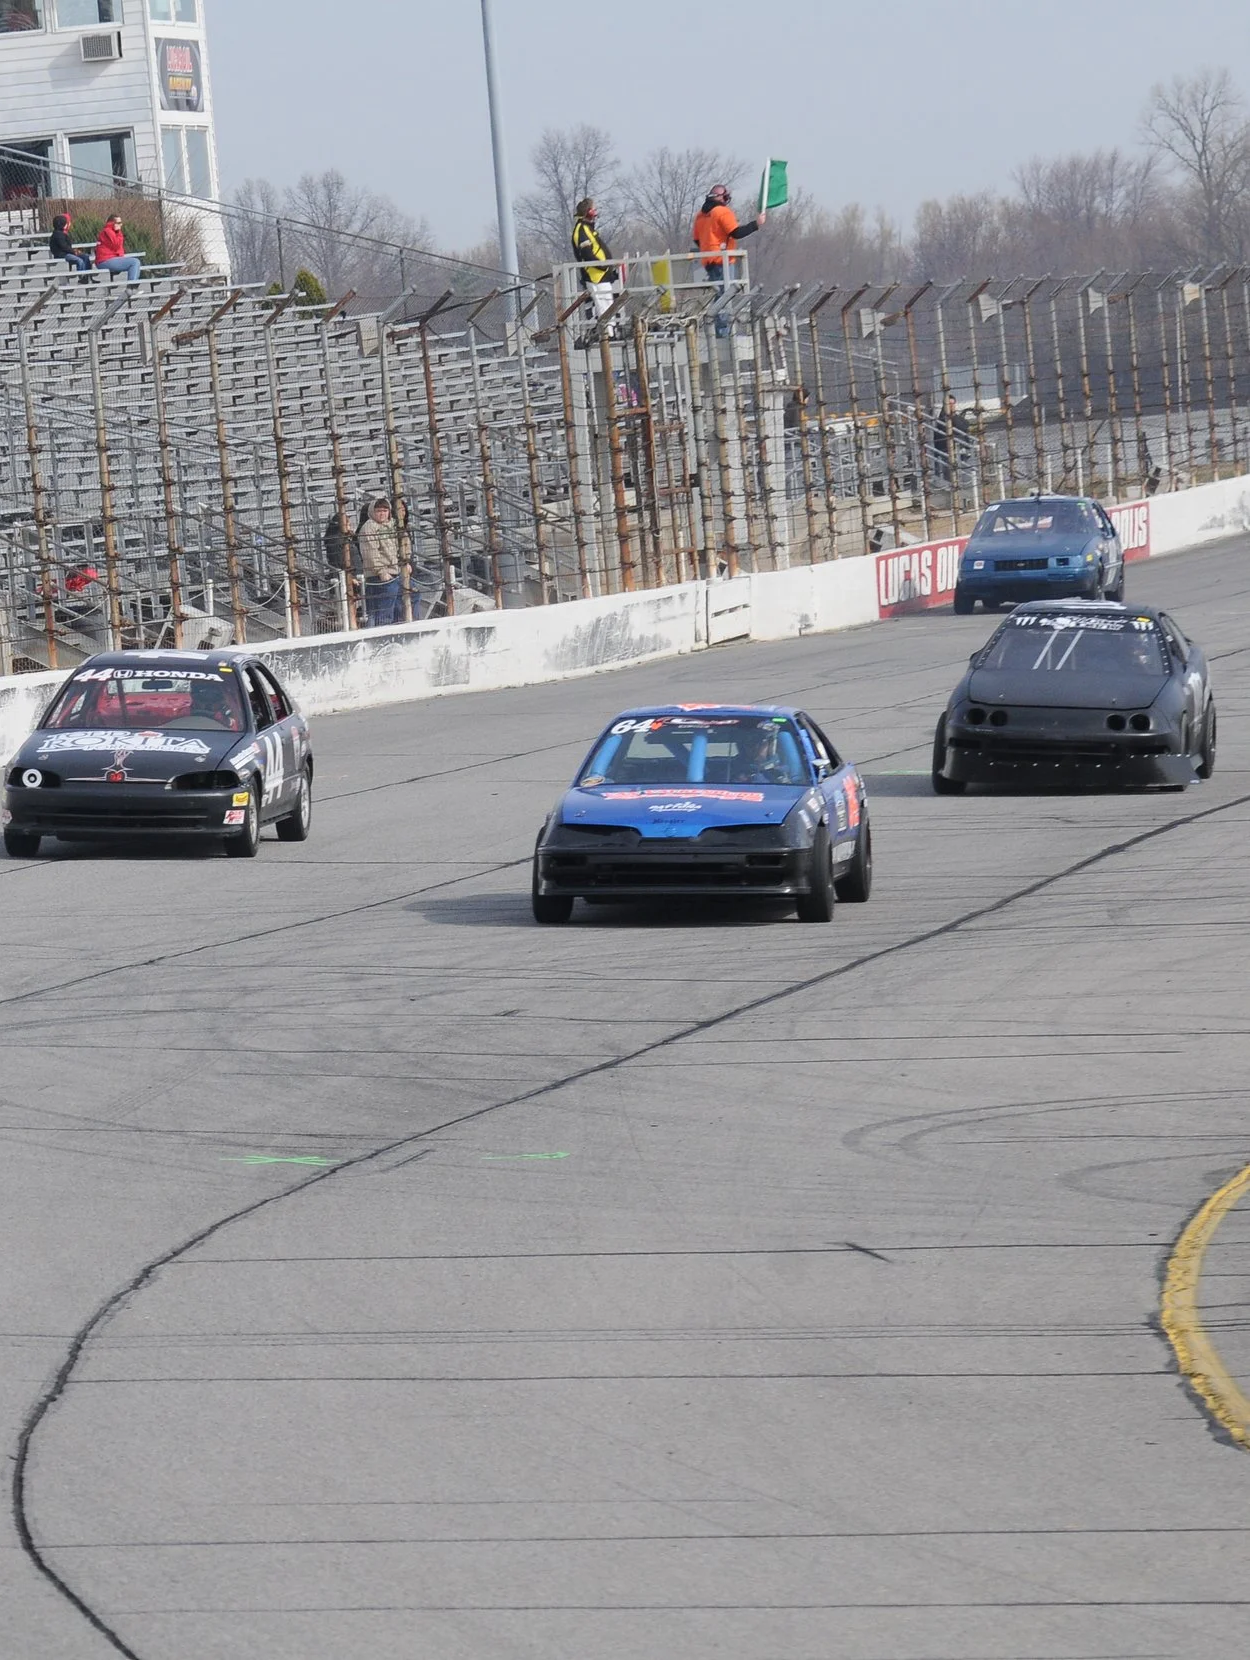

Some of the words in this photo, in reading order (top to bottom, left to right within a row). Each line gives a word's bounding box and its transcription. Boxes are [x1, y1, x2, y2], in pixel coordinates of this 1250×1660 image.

[879, 549, 933, 606] LUCAS
[72, 667, 114, 682] 44
[134, 670, 224, 682] HONDA
[611, 719, 655, 735] 64
[37, 736, 212, 753] ROKITA
